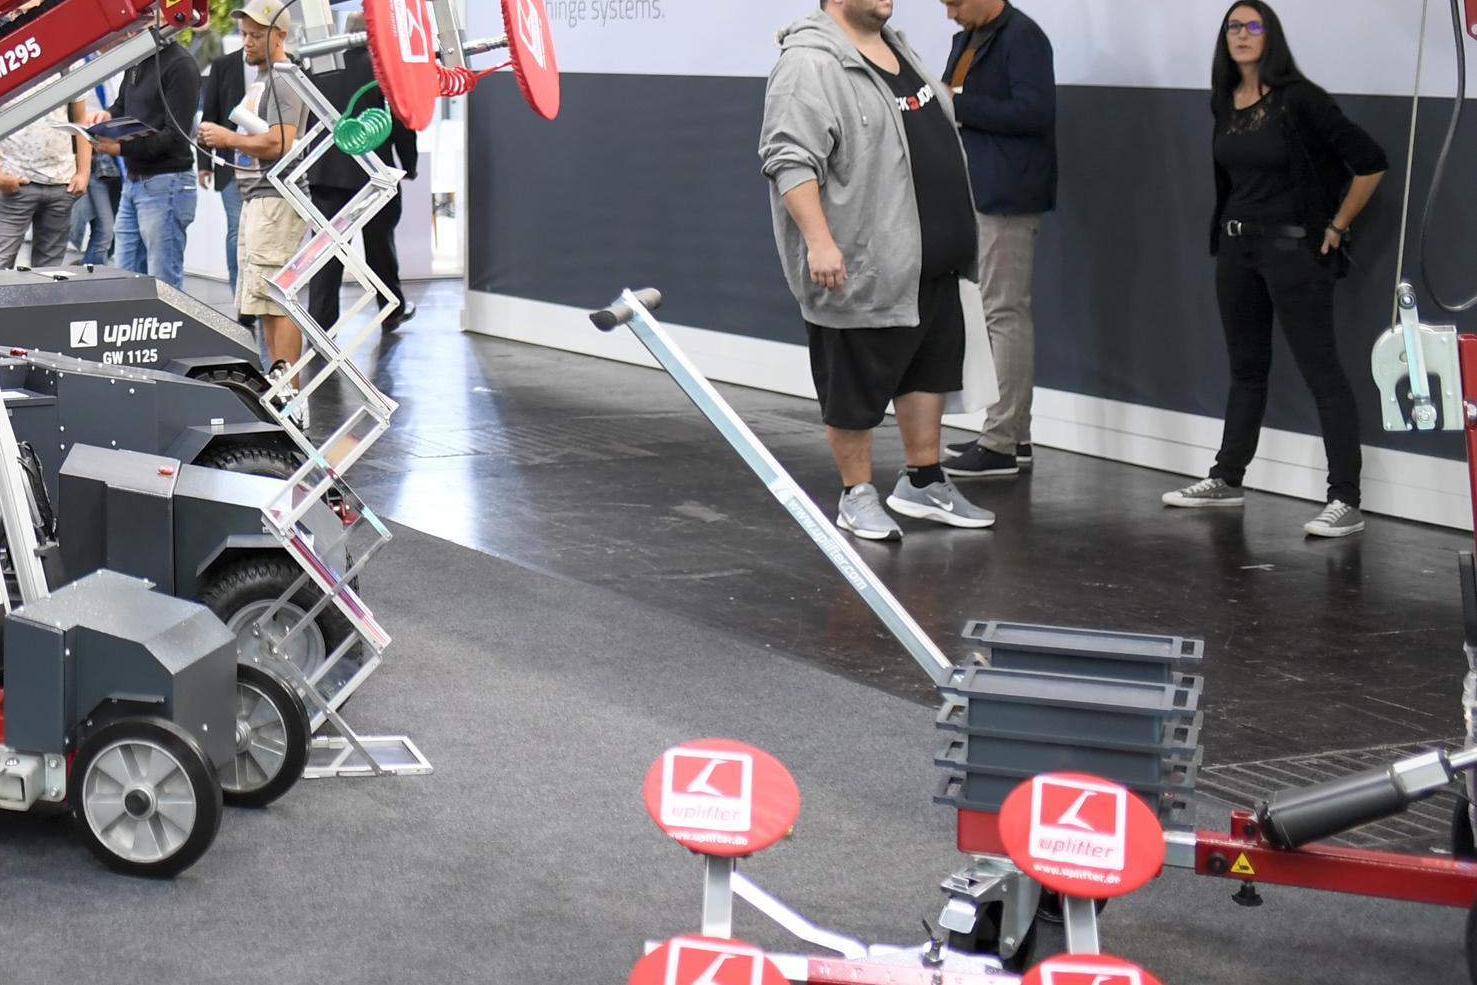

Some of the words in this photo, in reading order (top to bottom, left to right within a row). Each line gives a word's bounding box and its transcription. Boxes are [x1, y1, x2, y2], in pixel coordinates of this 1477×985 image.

[103, 317, 183, 347] uplifter
[103, 350, 124, 365] GW
[127, 349, 158, 364] 1125
[1038, 837, 1116, 858] uplifter
[1032, 863, 1122, 885] www.uplifter.de
